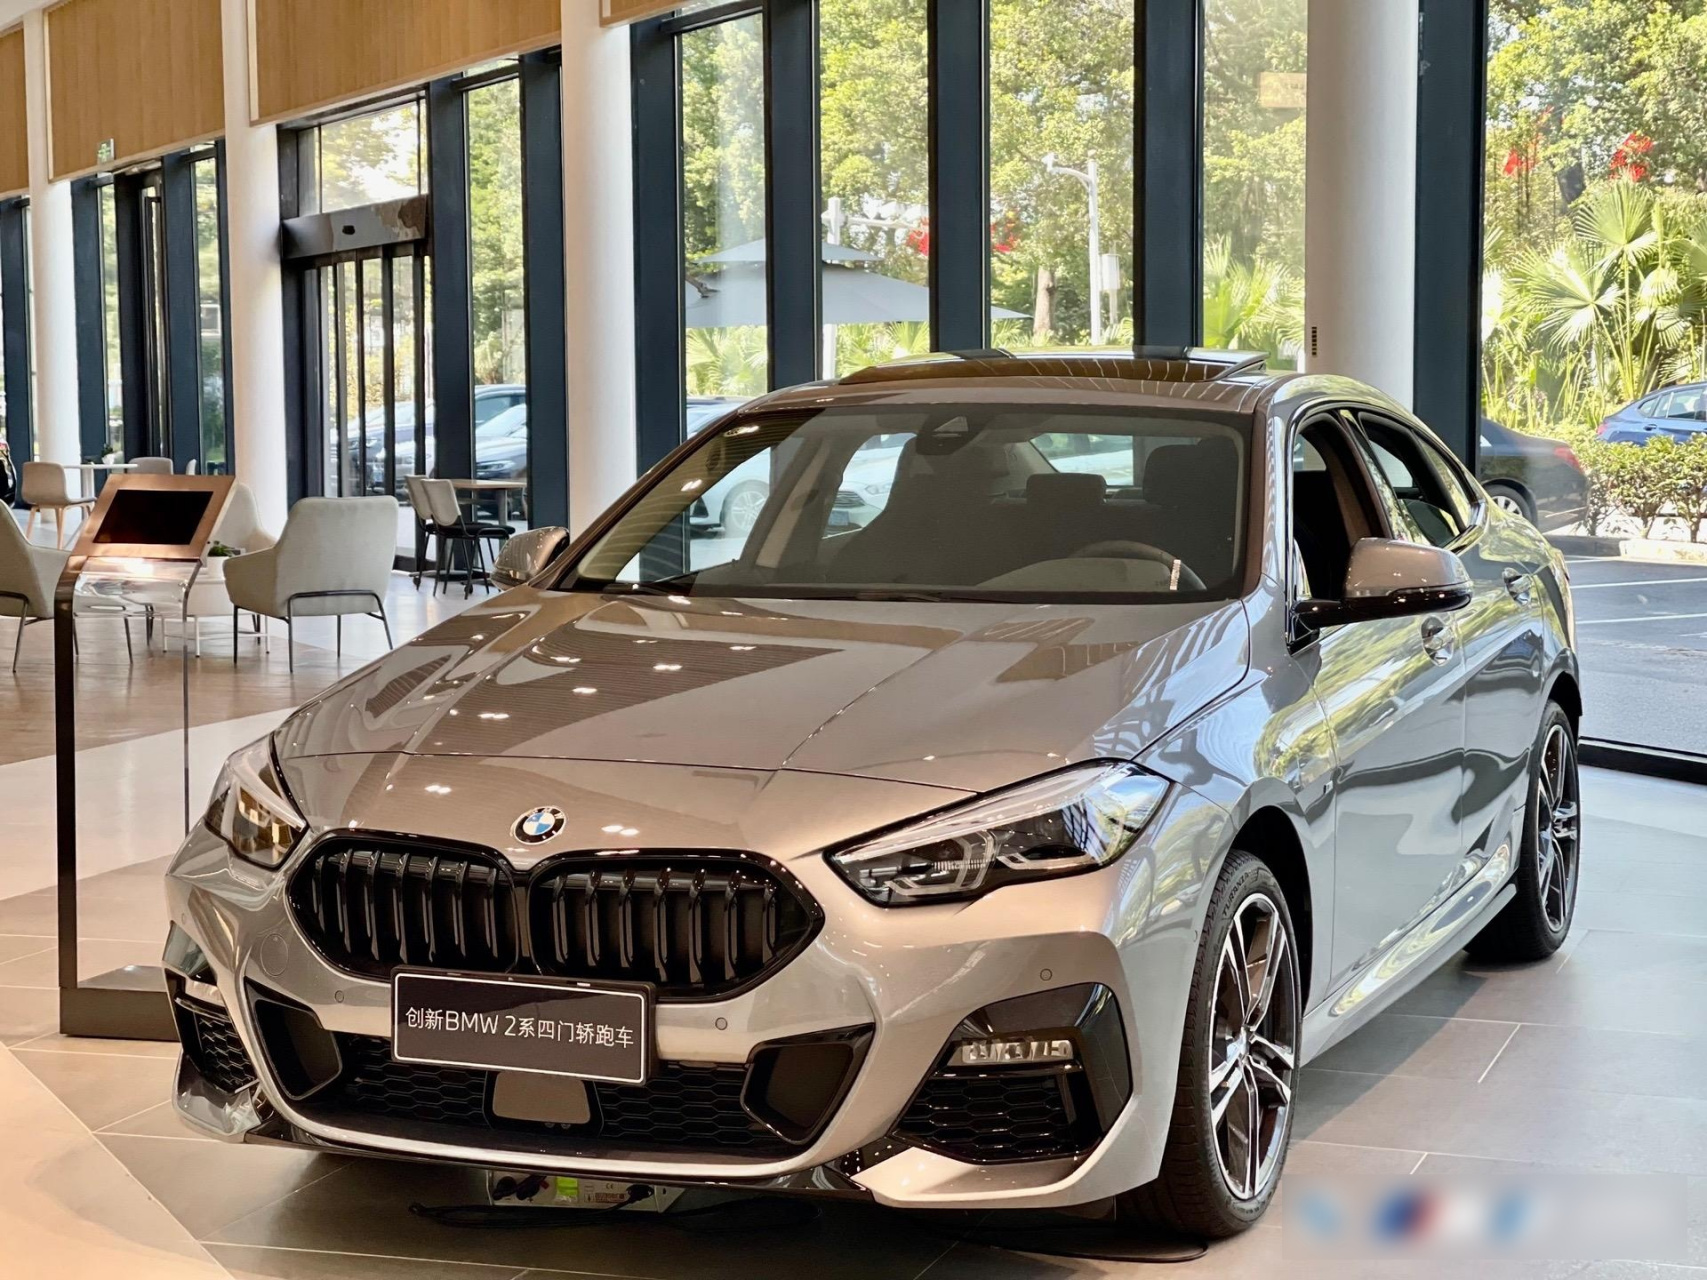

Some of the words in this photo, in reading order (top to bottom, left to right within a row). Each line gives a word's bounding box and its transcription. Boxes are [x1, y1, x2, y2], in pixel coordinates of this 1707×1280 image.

[1222, 872, 1250, 916] TURANZA
[405, 1006, 499, 1034] 创新BMW
[504, 1015, 634, 1049] 2系四门轿跑车
